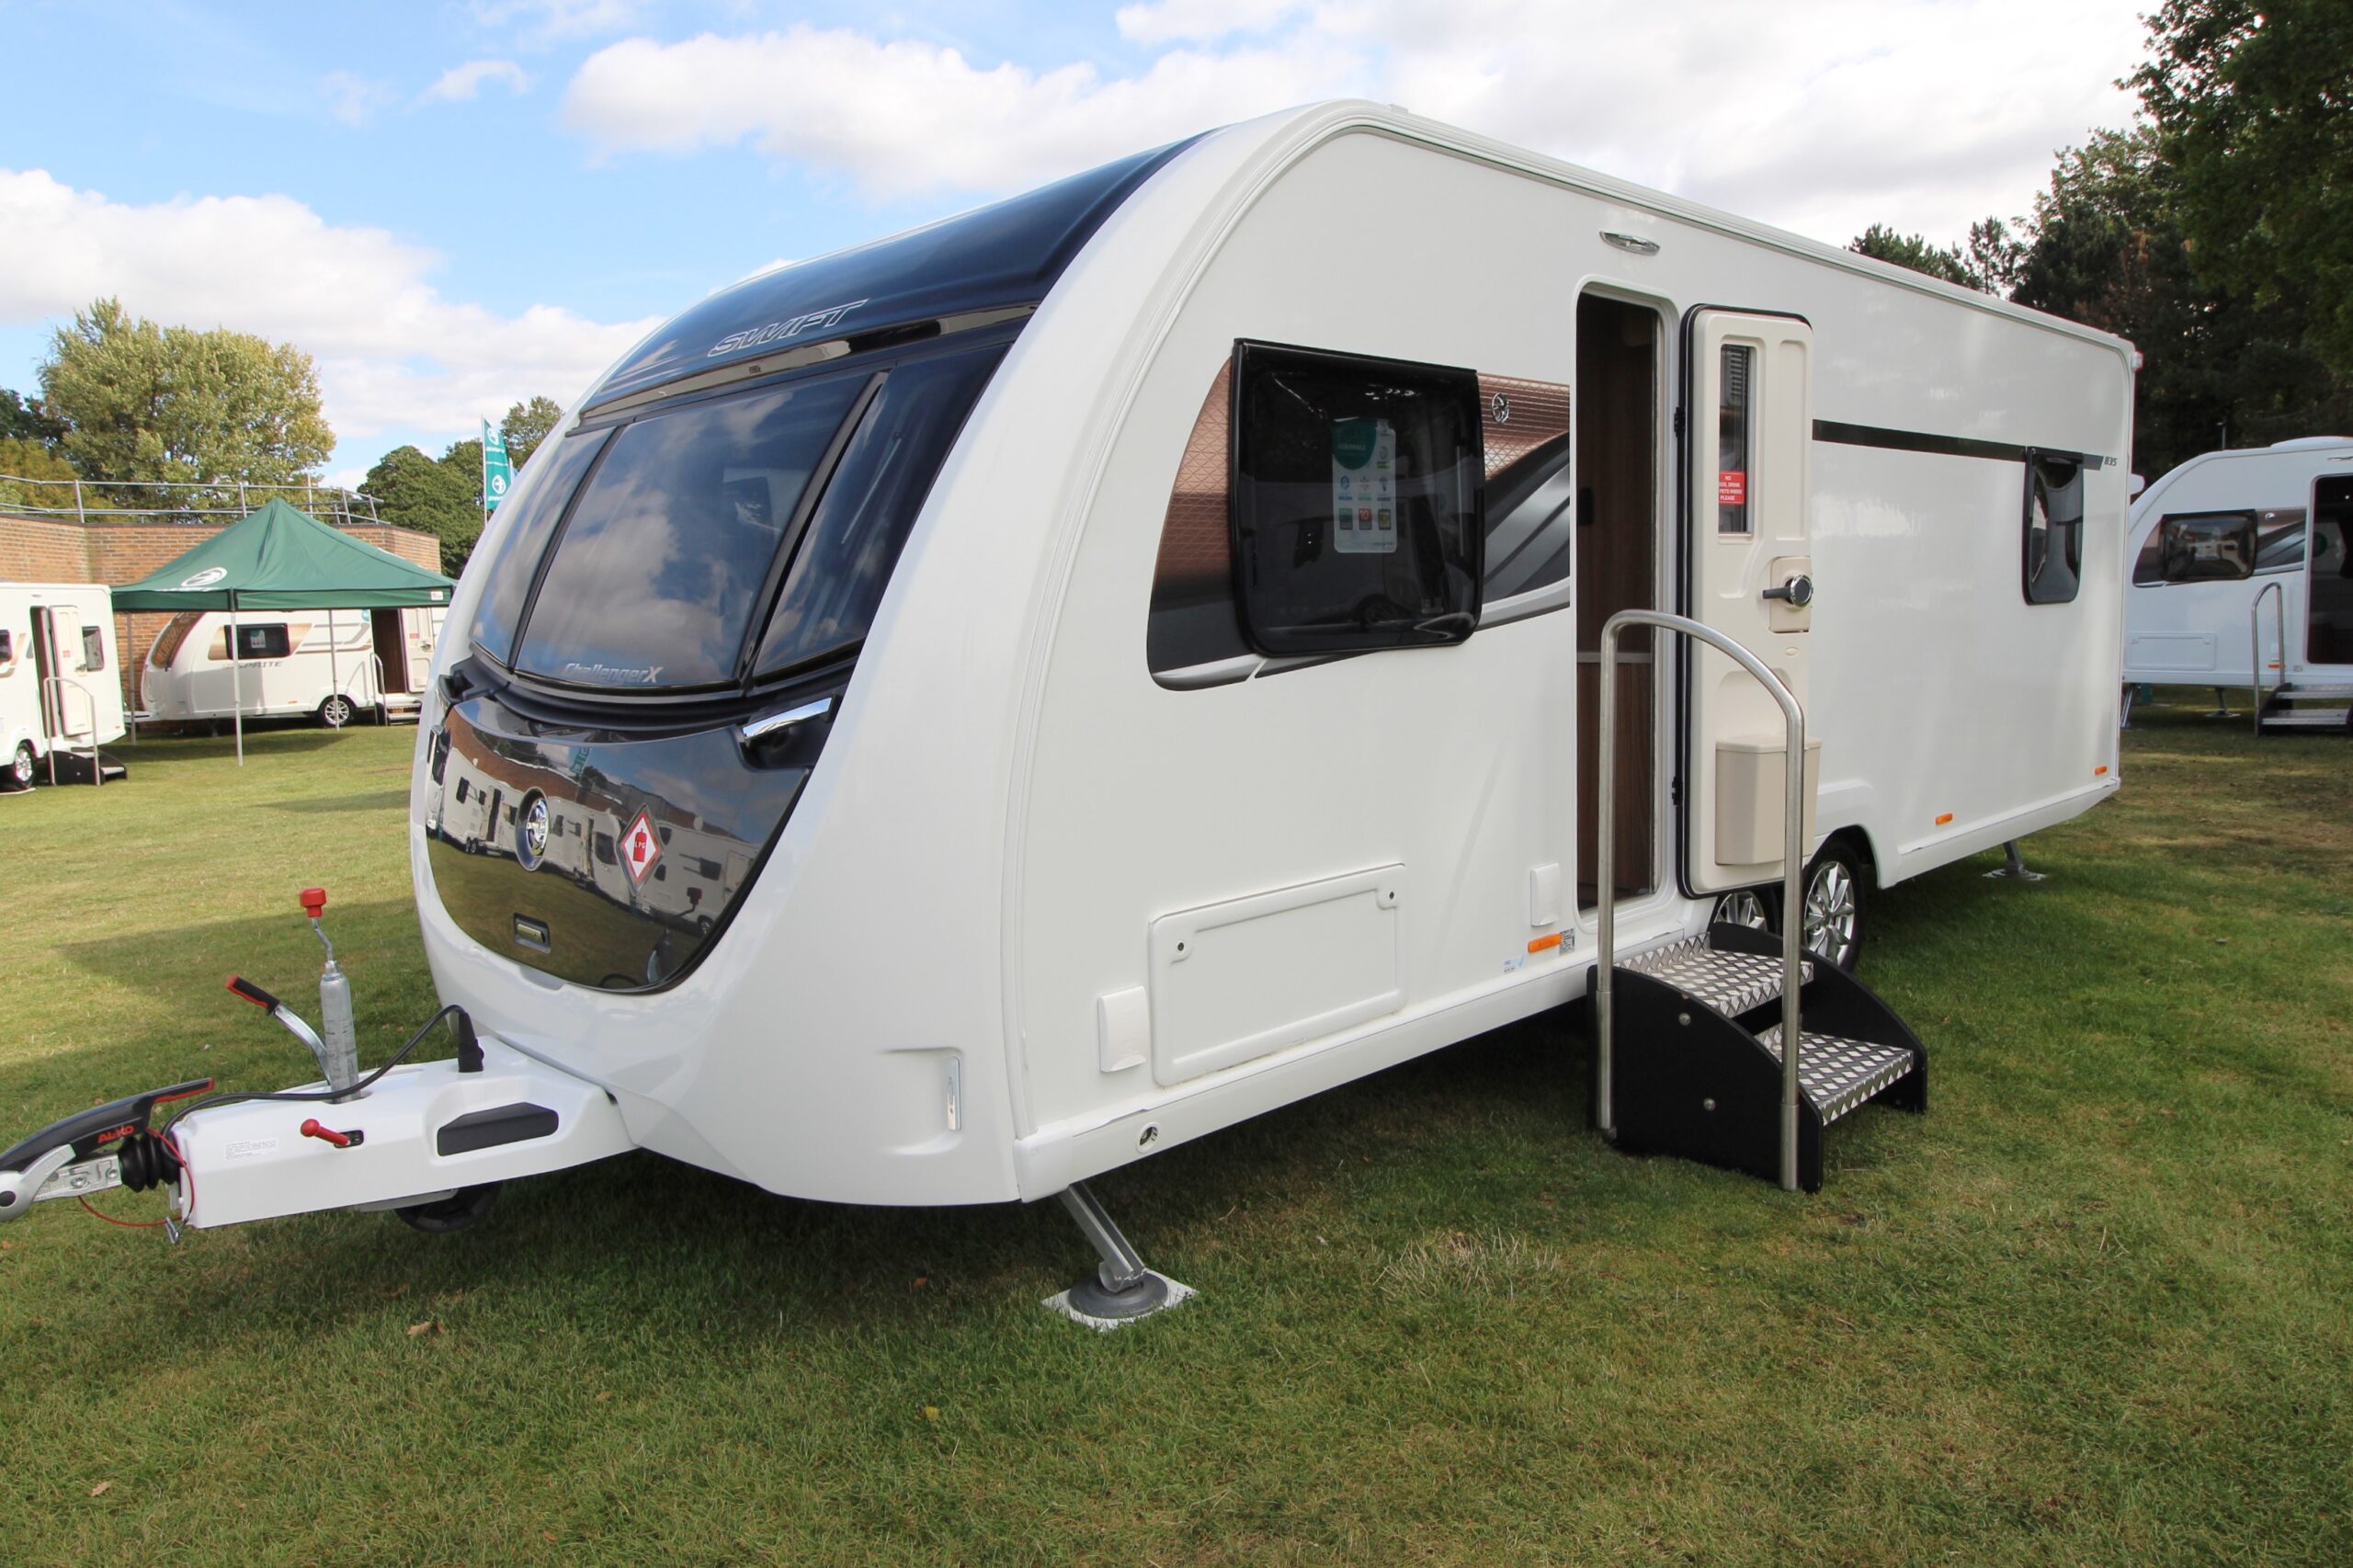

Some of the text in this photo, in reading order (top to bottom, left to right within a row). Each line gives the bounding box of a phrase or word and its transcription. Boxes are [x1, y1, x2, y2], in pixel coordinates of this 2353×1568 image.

[707, 298, 870, 357] SWIFT
[2104, 456, 2118, 467] 835
[634, 841, 647, 849] LPG
